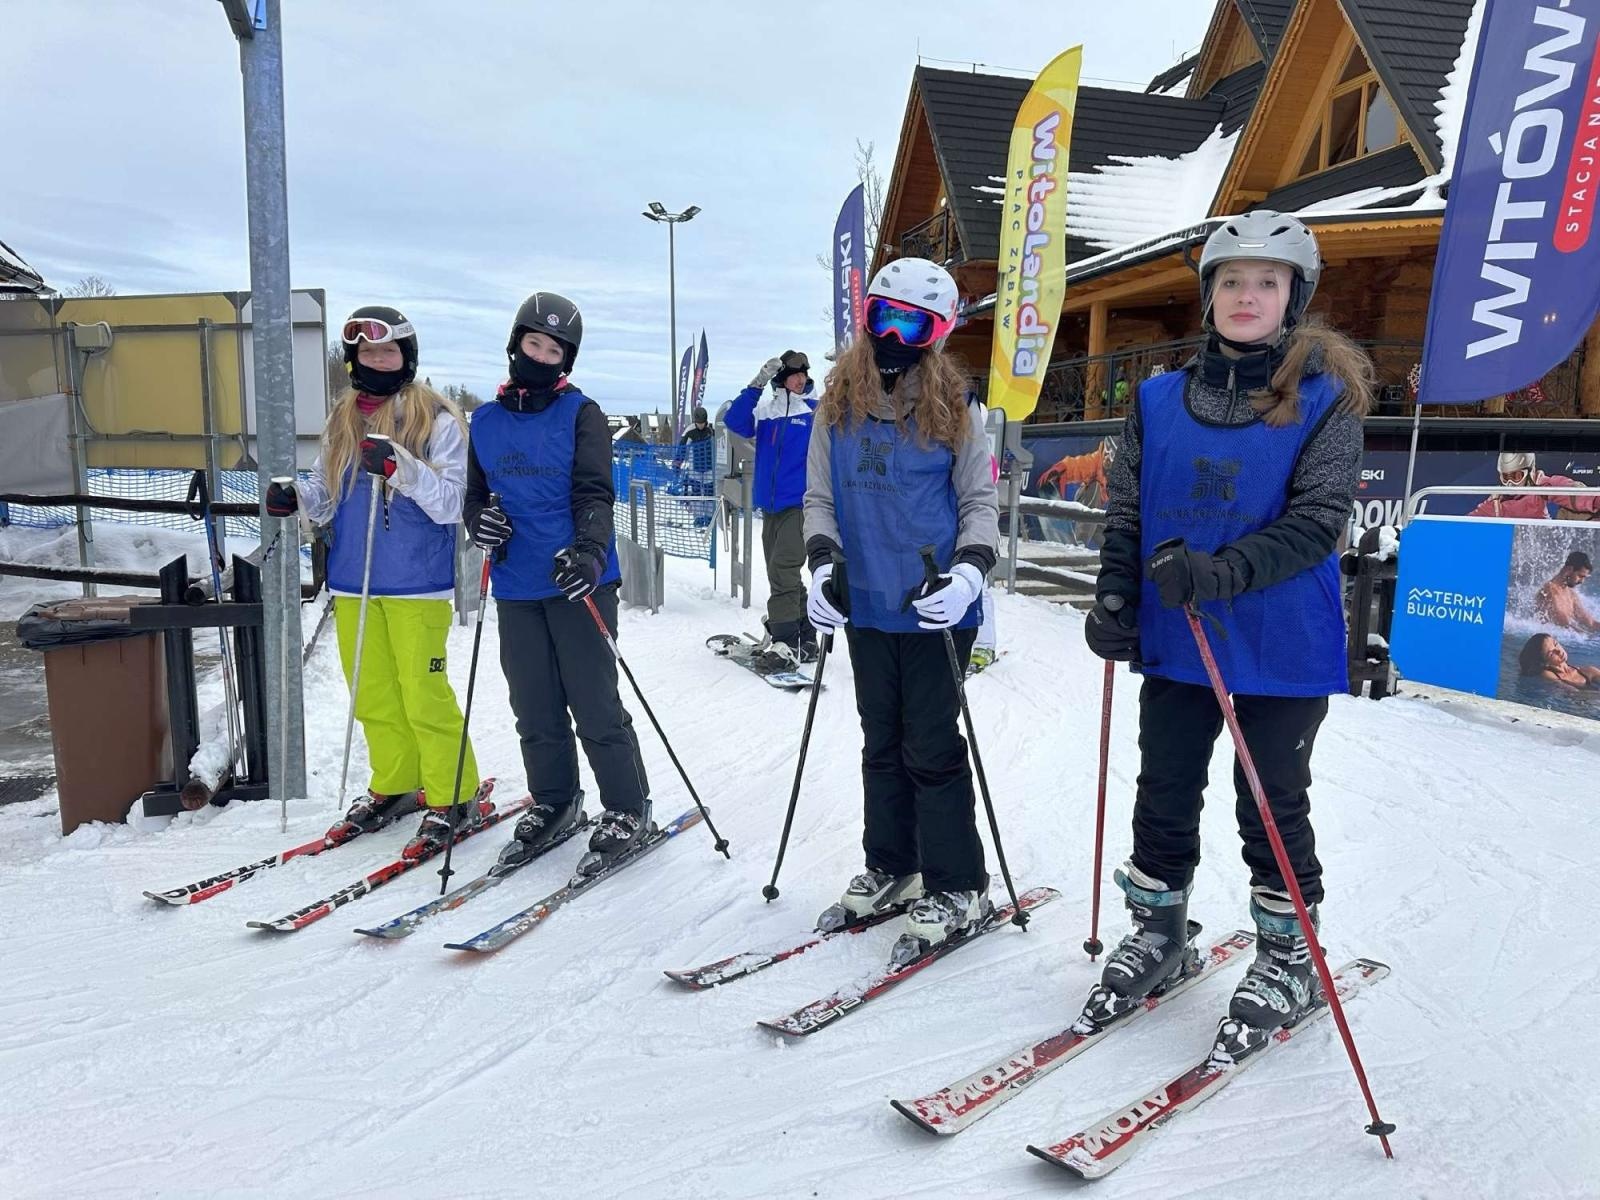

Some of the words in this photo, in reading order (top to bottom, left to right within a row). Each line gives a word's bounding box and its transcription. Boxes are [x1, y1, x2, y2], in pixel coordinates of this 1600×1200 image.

[1012, 169, 1023, 231] PLAC
[1565, 137, 1598, 232] STACJA
[1003, 247, 1019, 329] ZABAW
[1361, 469, 1385, 480] SKI
[1406, 602, 1484, 625] BUKOVINA
[1433, 590, 1487, 609] TERMY
[942, 1047, 1037, 1109] ATOM
[1083, 1086, 1171, 1156] ATOM
